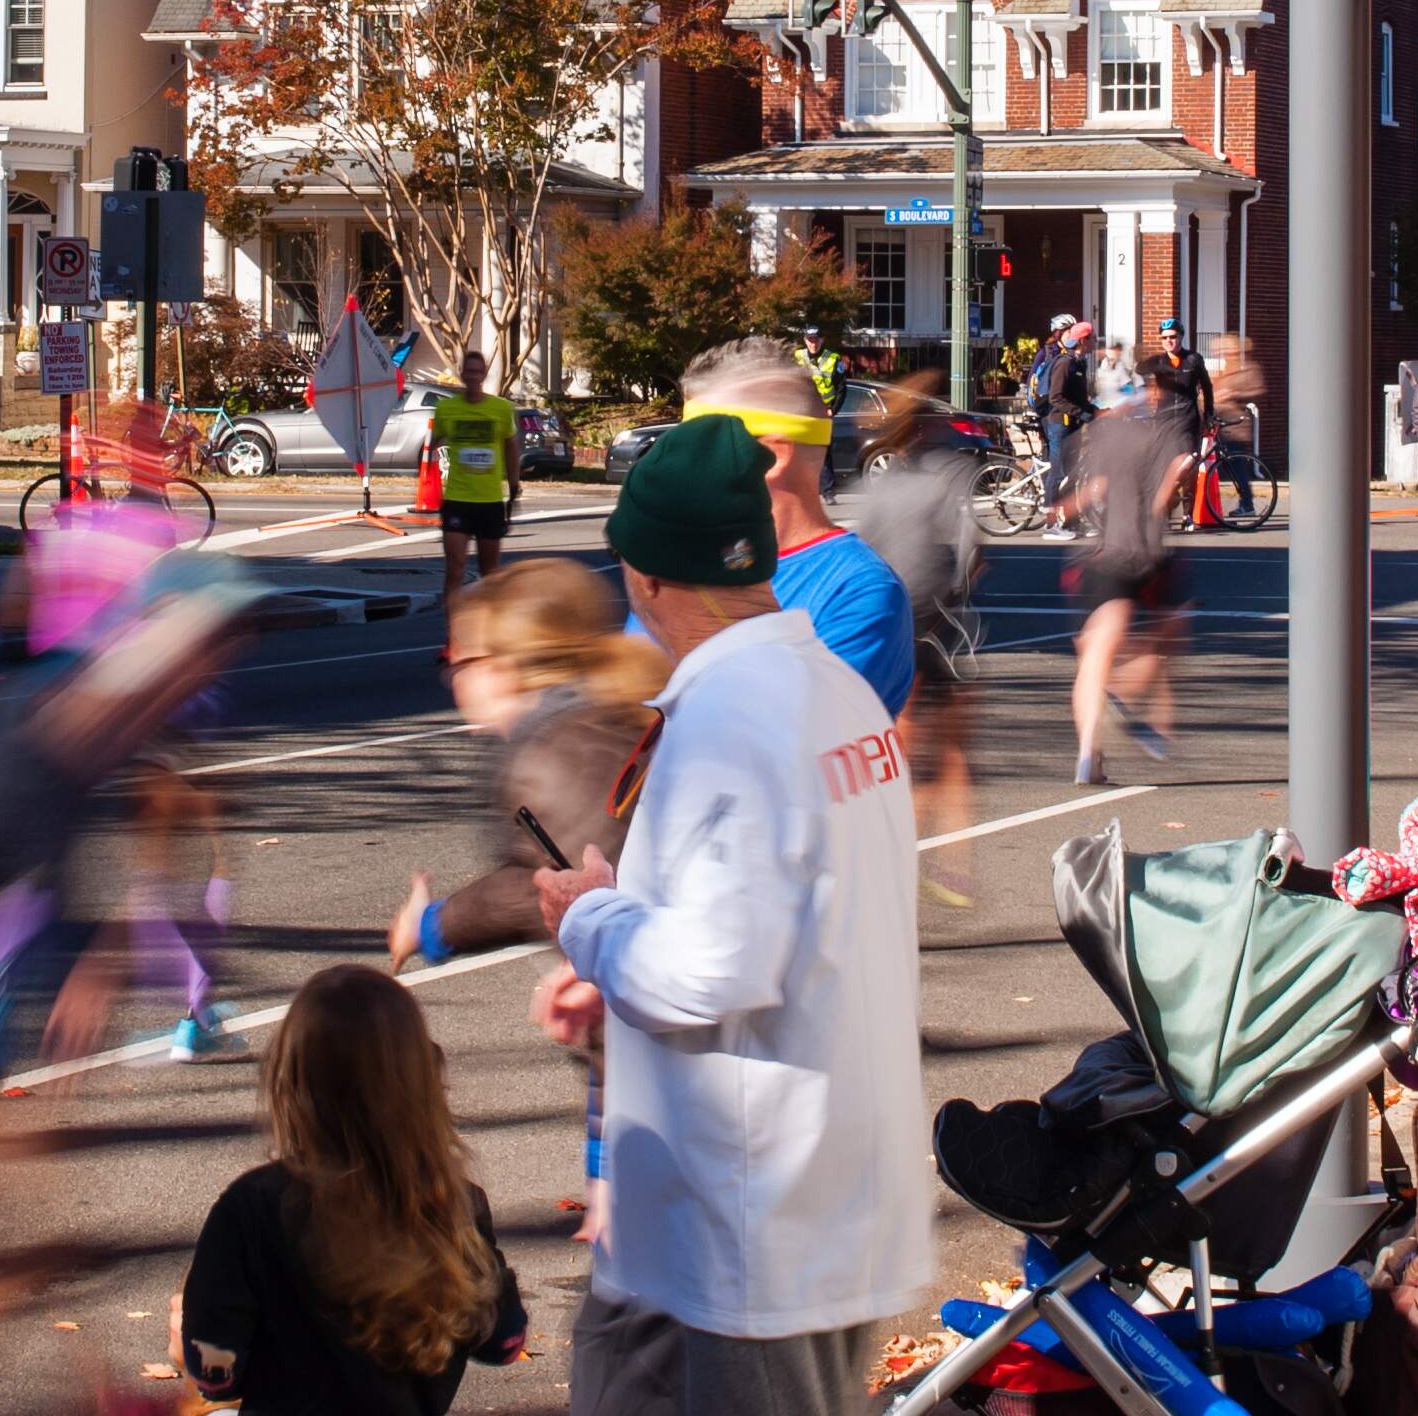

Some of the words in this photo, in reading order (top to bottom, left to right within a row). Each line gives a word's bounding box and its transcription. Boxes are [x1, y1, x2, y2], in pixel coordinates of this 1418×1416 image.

[889, 211, 896, 221] S
[899, 210, 950, 221] BOULEVARD
[1117, 253, 1126, 266] 2
[44, 325, 58, 335] NO
[47, 335, 80, 346] PARKING
[49, 346, 80, 355] TOWING
[44, 354, 84, 365] ENFORCED
[47, 366, 82, 374] Saturday
[1106, 1309, 1138, 1338] FITNESS
